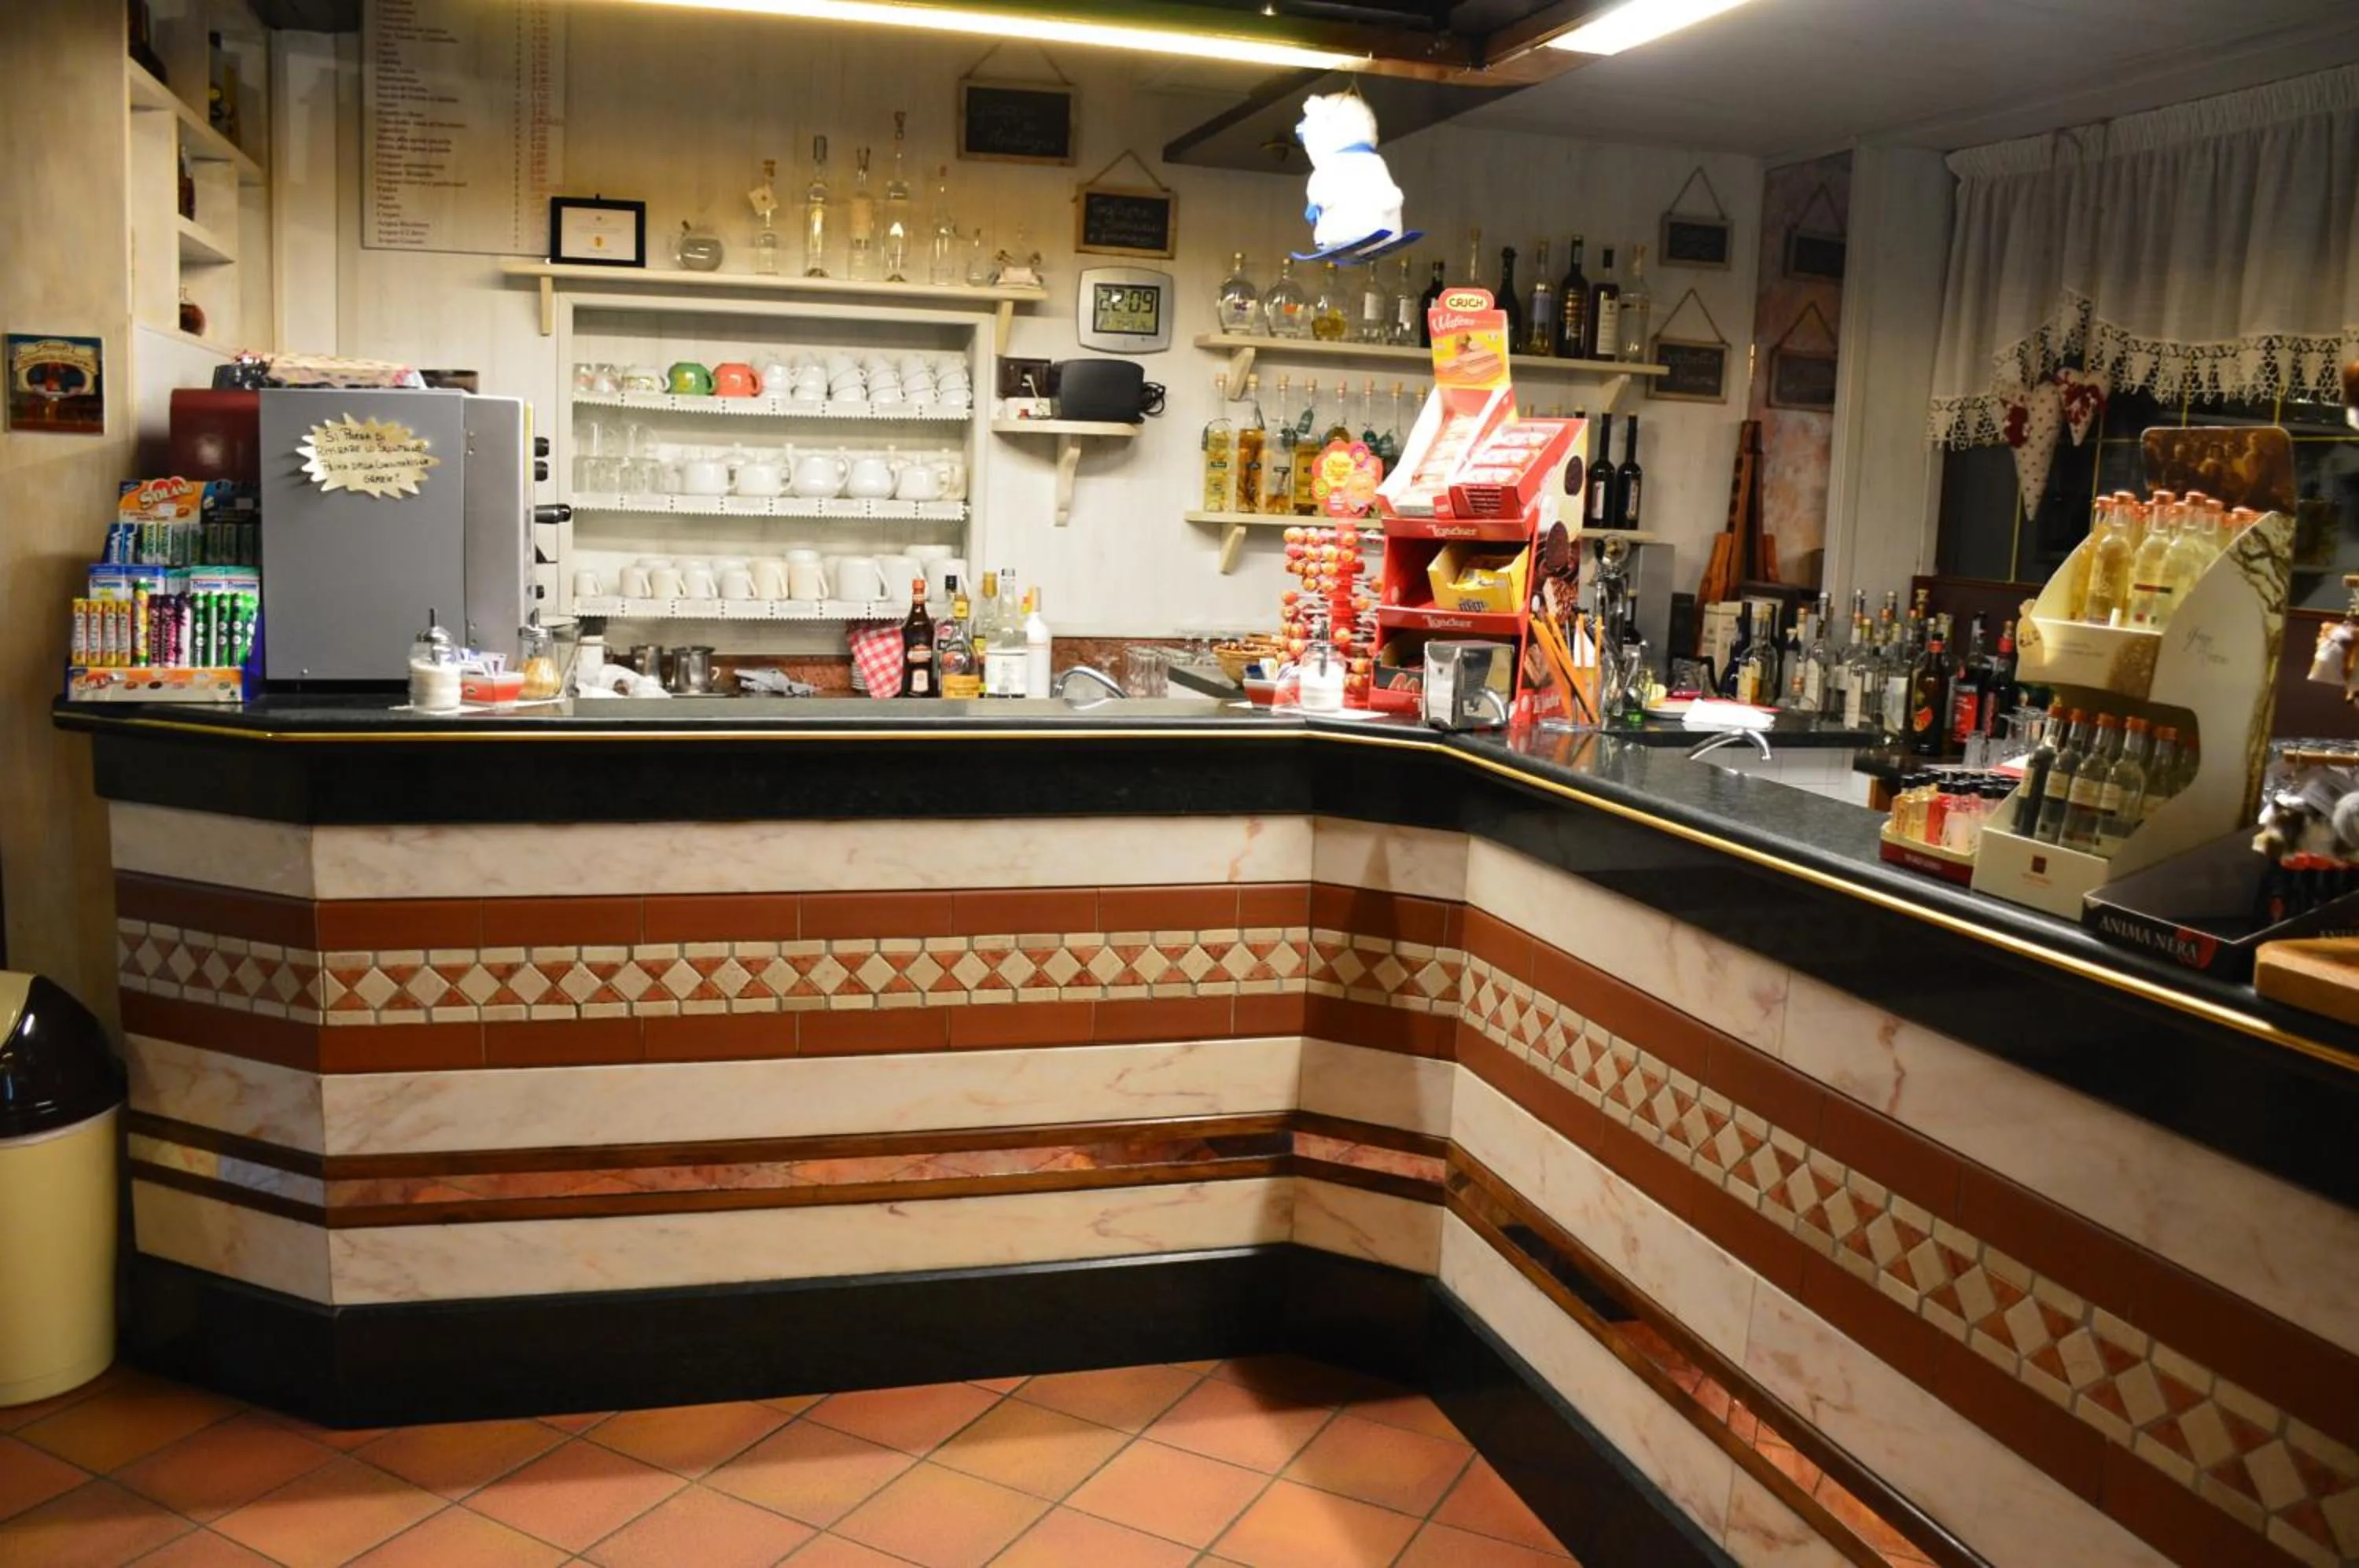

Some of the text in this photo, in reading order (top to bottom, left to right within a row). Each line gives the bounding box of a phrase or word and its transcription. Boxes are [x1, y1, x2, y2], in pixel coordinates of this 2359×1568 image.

[1099, 289, 1154, 314] 22:09
[1448, 297, 1484, 308] CRICH
[2099, 915, 2199, 965] ANIMA NERA
